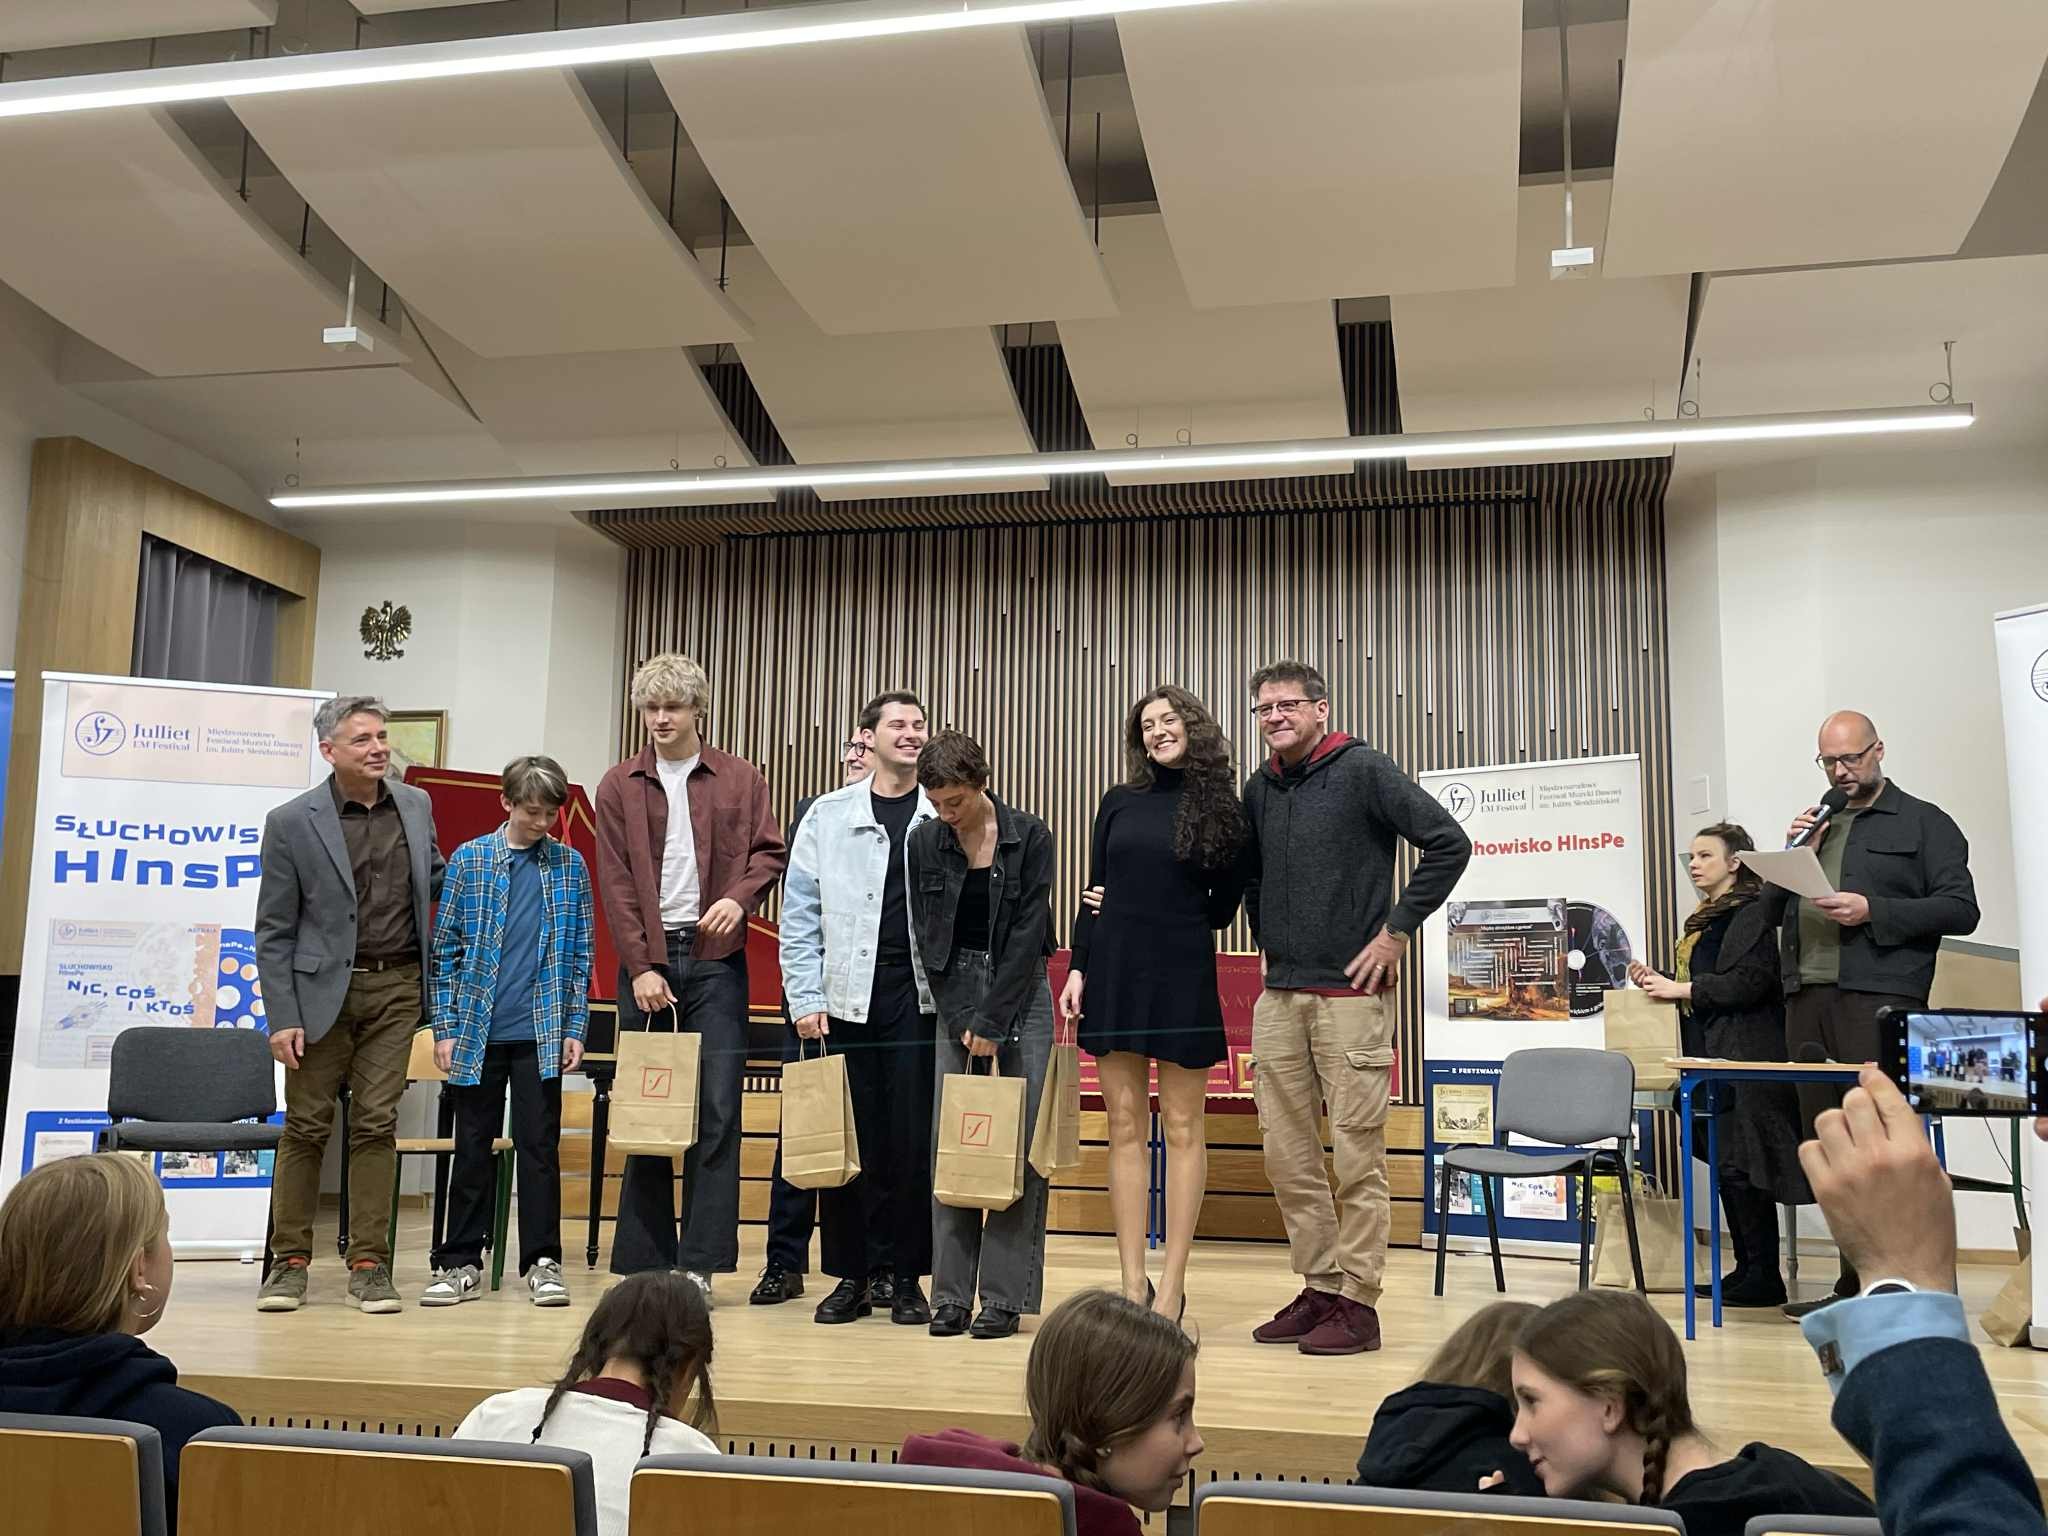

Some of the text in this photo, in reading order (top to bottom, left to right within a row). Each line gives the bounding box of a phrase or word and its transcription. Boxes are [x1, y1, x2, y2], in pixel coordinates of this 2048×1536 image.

[132, 723, 191, 741] Julliet
[133, 739, 190, 751] EM Festival
[1480, 788, 1526, 804] Julliet
[1496, 803, 1527, 812] Festival
[55, 815, 260, 846] SŁUCHOWIS
[1472, 837, 1553, 857] howisko
[53, 848, 262, 890] HInsP
[67, 979, 157, 999] NIC, COŚ
[146, 1000, 195, 1015] KTOŚ
